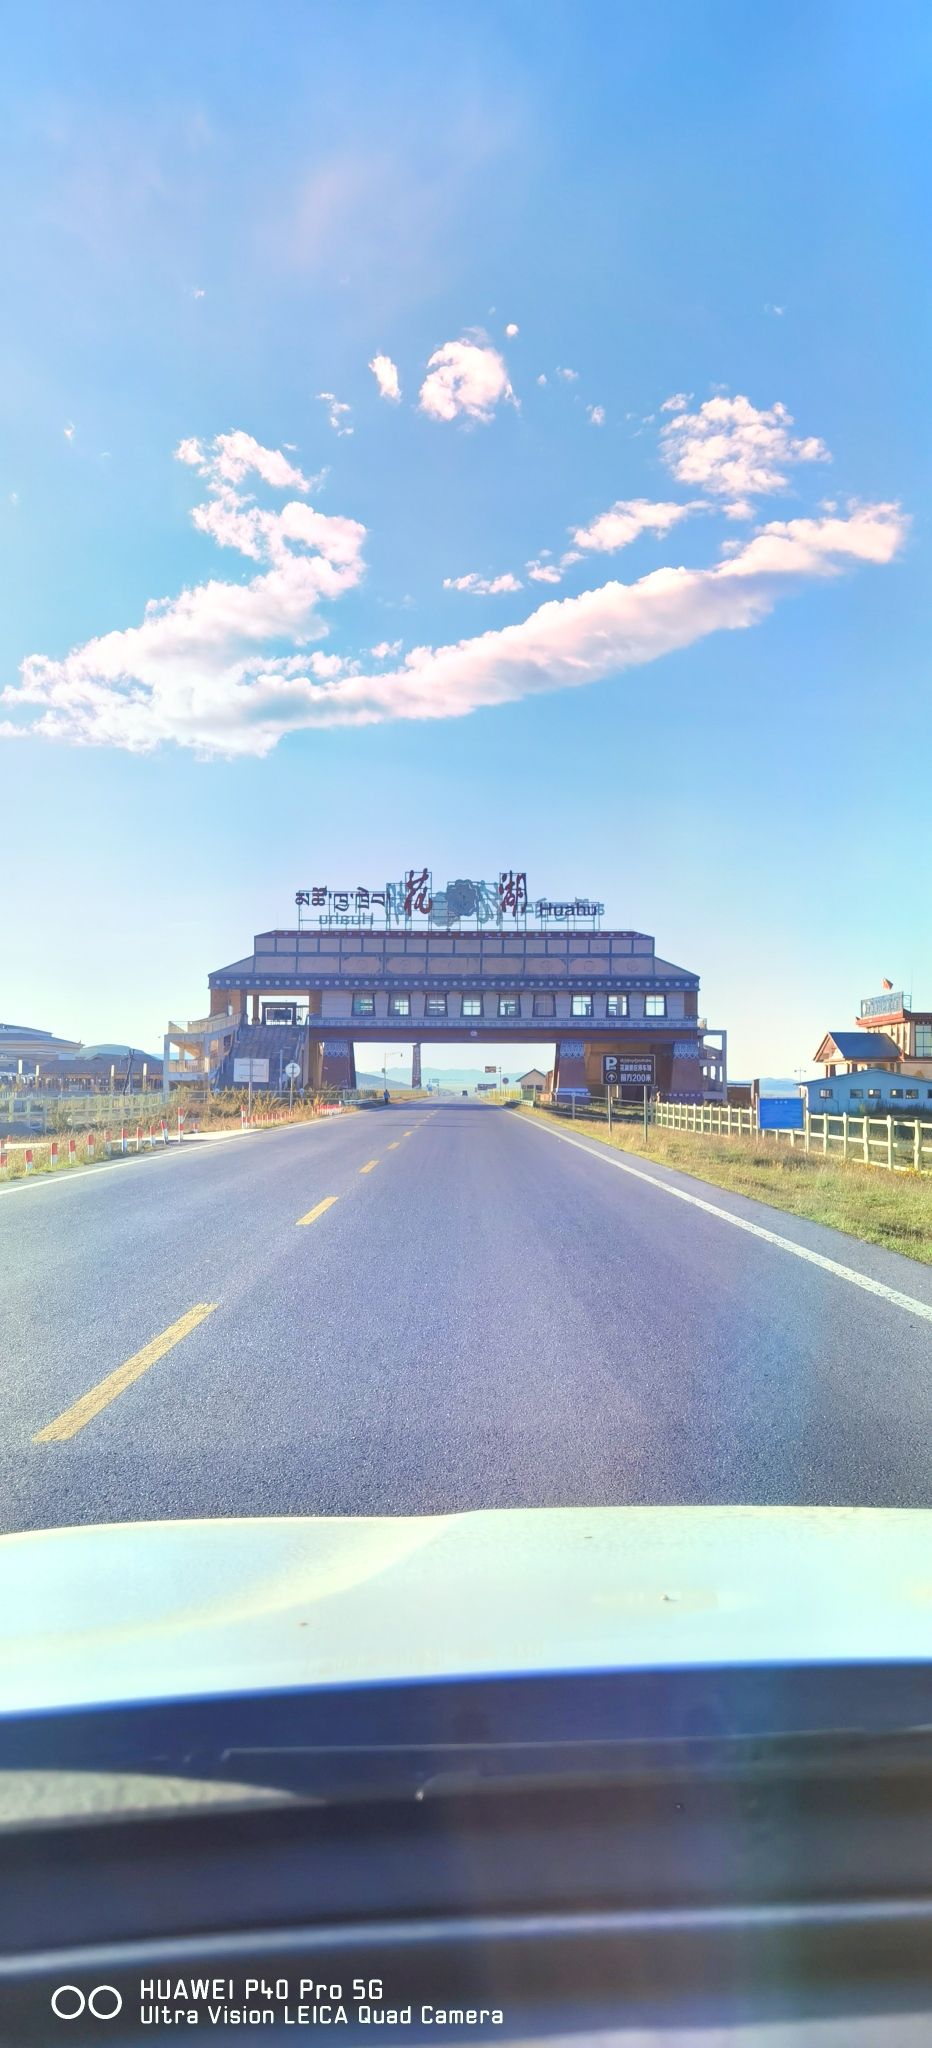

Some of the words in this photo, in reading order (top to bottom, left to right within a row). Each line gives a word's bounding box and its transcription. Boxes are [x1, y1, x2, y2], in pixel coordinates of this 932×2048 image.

[404, 868, 433, 917] 花
[498, 870, 527, 917] 湖
[540, 902, 598, 916] Huahu
[605, 1057, 617, 1070] P
[620, 1073, 652, 1082] 前方200米
